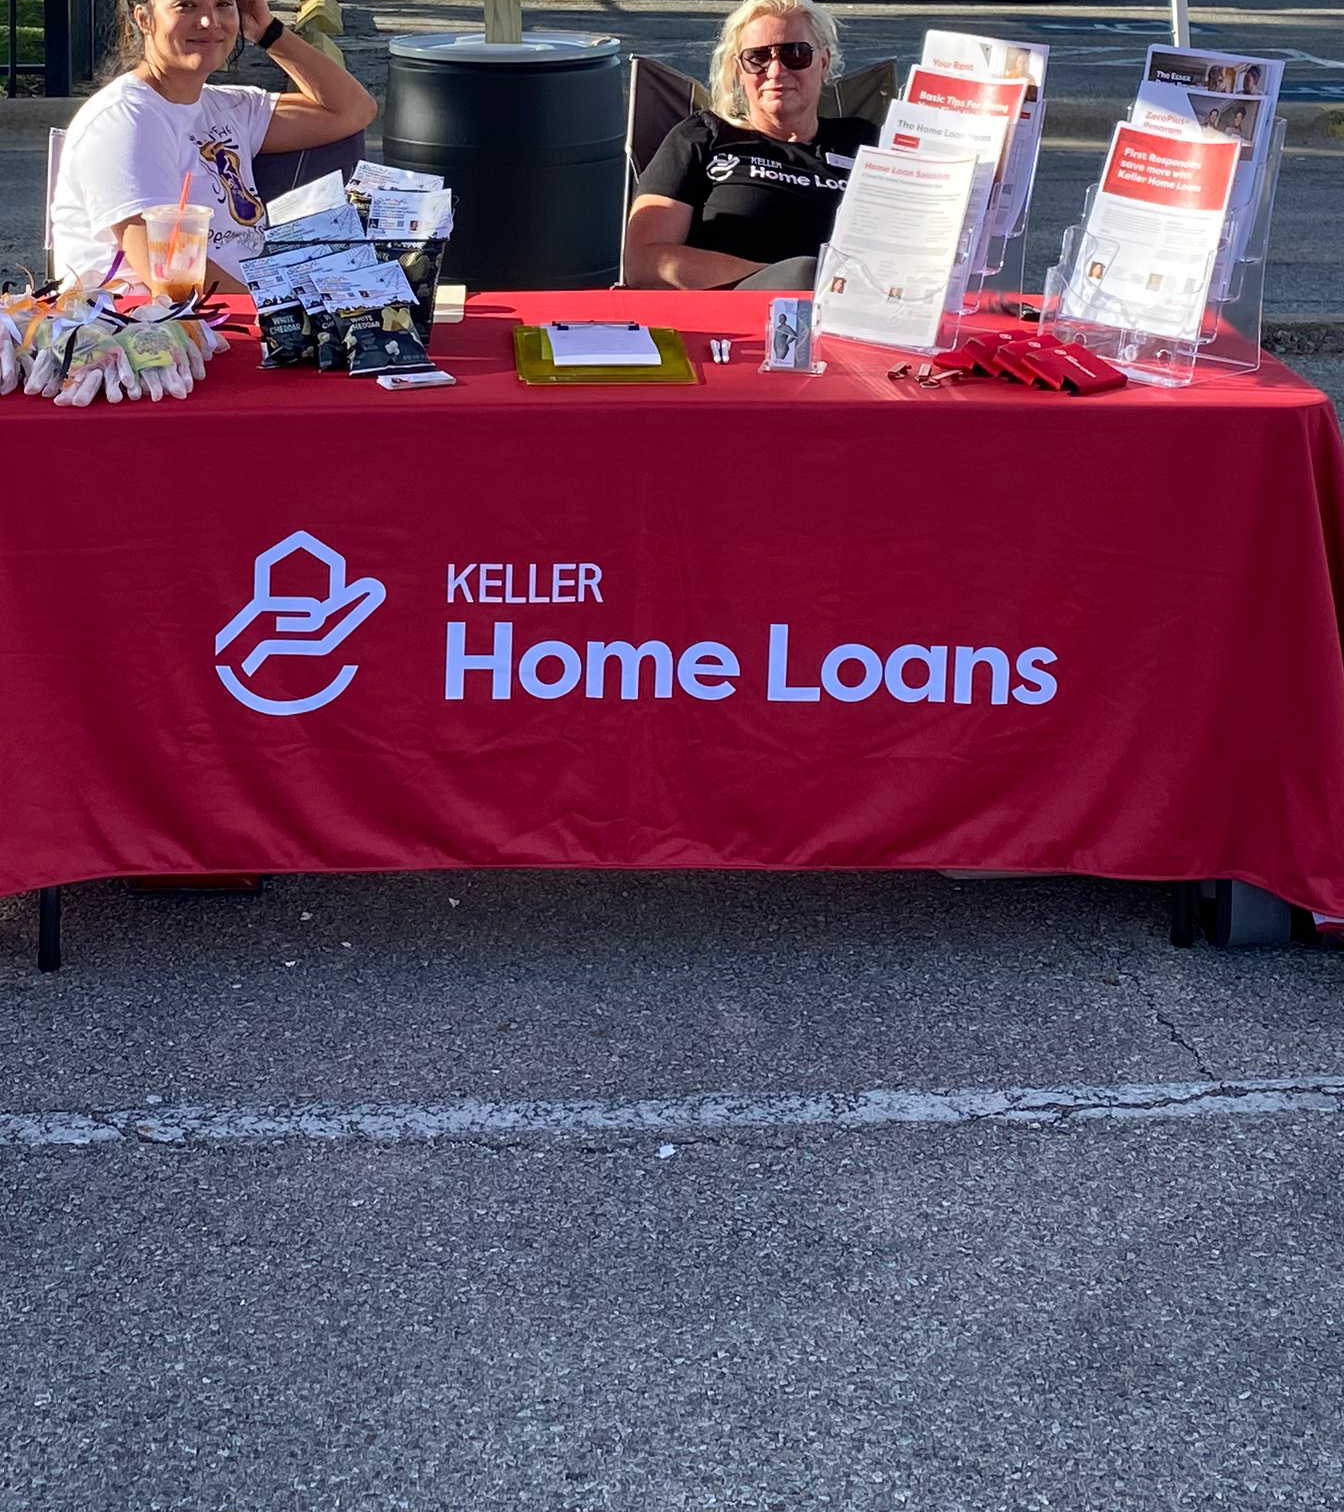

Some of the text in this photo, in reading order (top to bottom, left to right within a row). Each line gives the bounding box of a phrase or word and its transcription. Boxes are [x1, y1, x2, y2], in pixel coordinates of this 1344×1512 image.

[933, 58, 974, 71] Your Rent
[1156, 70, 1171, 80] The
[919, 91, 945, 103] Basic
[947, 96, 965, 108] Tips
[897, 119, 915, 130] The
[916, 123, 943, 136] Home
[1123, 147, 1147, 161] First
[750, 166, 811, 187] Home
[891, 166, 914, 177] Loan
[1120, 159, 1145, 172] save
[1146, 165, 1171, 178] more
[1117, 169, 1147, 184] Keller
[1148, 176, 1175, 189] Home
[447, 563, 603, 603] KELLER
[445, 622, 1058, 705] Home Loans
